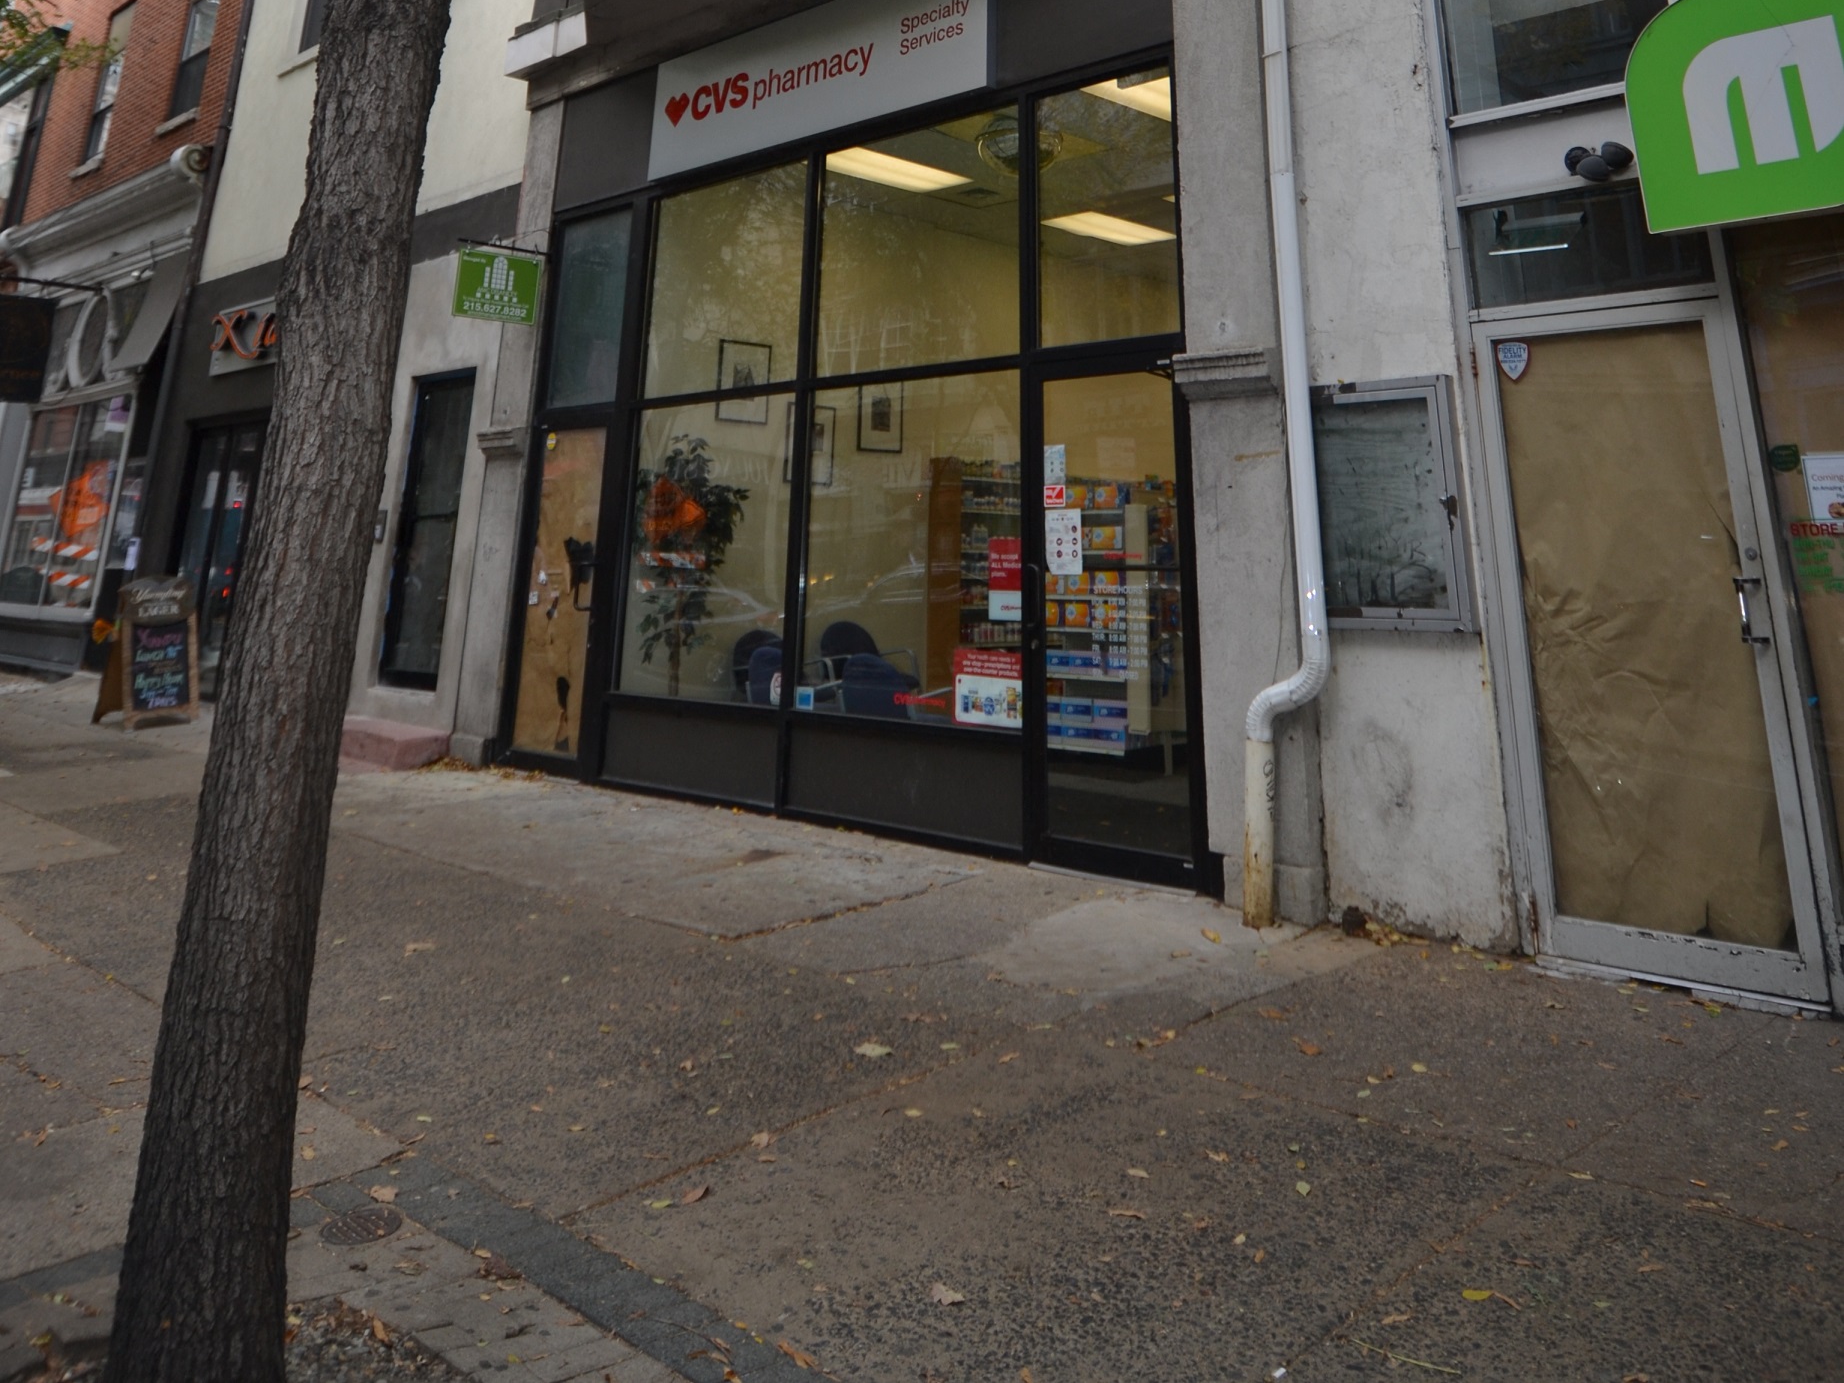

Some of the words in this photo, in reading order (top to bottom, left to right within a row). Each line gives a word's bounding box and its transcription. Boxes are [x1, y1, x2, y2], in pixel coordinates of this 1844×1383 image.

[899, 21, 964, 56] Services
[690, 72, 750, 121] CVS
[752, 42, 874, 110] pharmacy
[463, 301, 527, 318] 215.627.8282
[1498, 347, 1526, 355] FIDELITY
[1790, 522, 1841, 538] STORE
[1000, 553, 1018, 561] accept
[991, 561, 1002, 569] ALL
[1093, 585, 1117, 595] STORE
[1117, 585, 1143, 595] HOURS
[138, 605, 180, 618] LAGER
